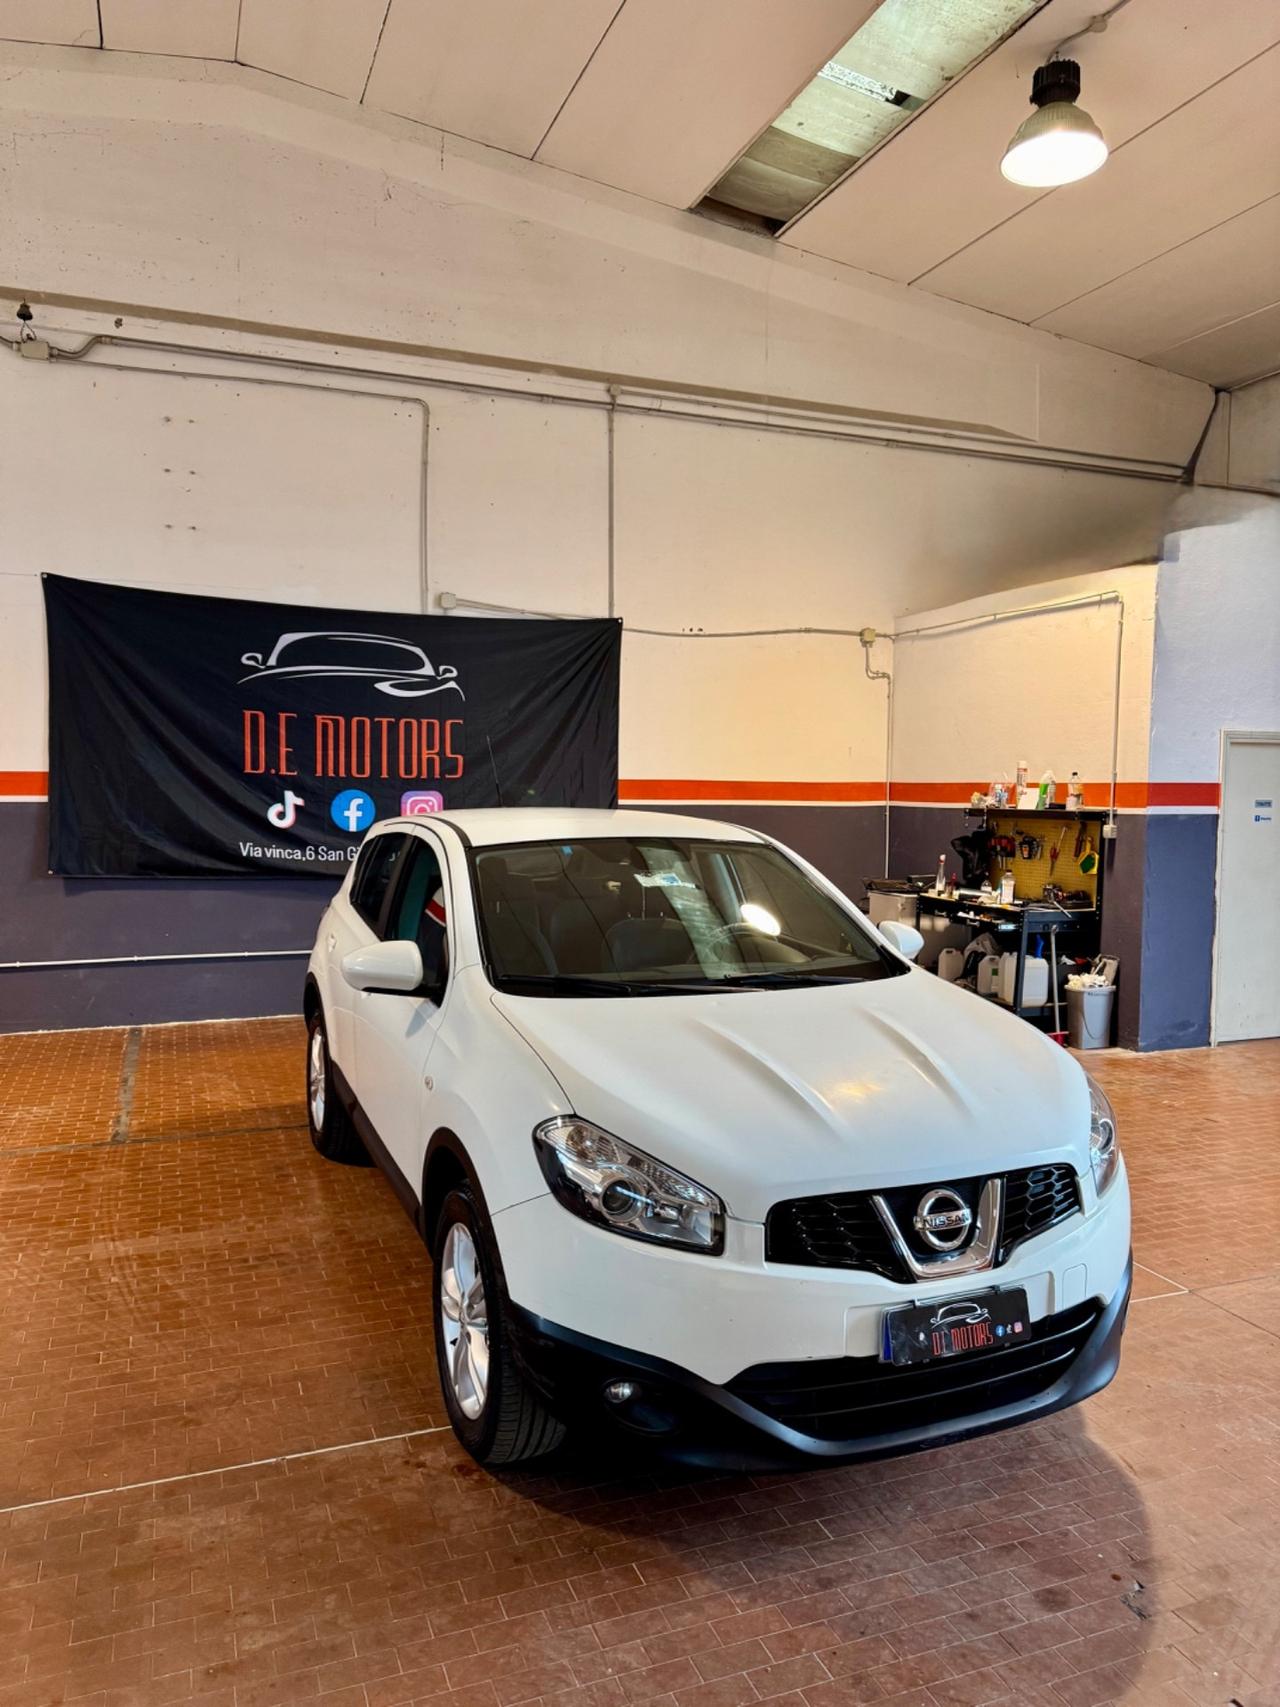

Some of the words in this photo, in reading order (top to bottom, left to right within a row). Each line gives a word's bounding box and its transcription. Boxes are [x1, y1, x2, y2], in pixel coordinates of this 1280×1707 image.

[242, 709, 298, 776] D.E
[314, 714, 465, 779] MOTORS
[239, 842, 262, 858] Via
[318, 846, 344, 861] San
[951, 1322, 994, 1352] MOTORS
